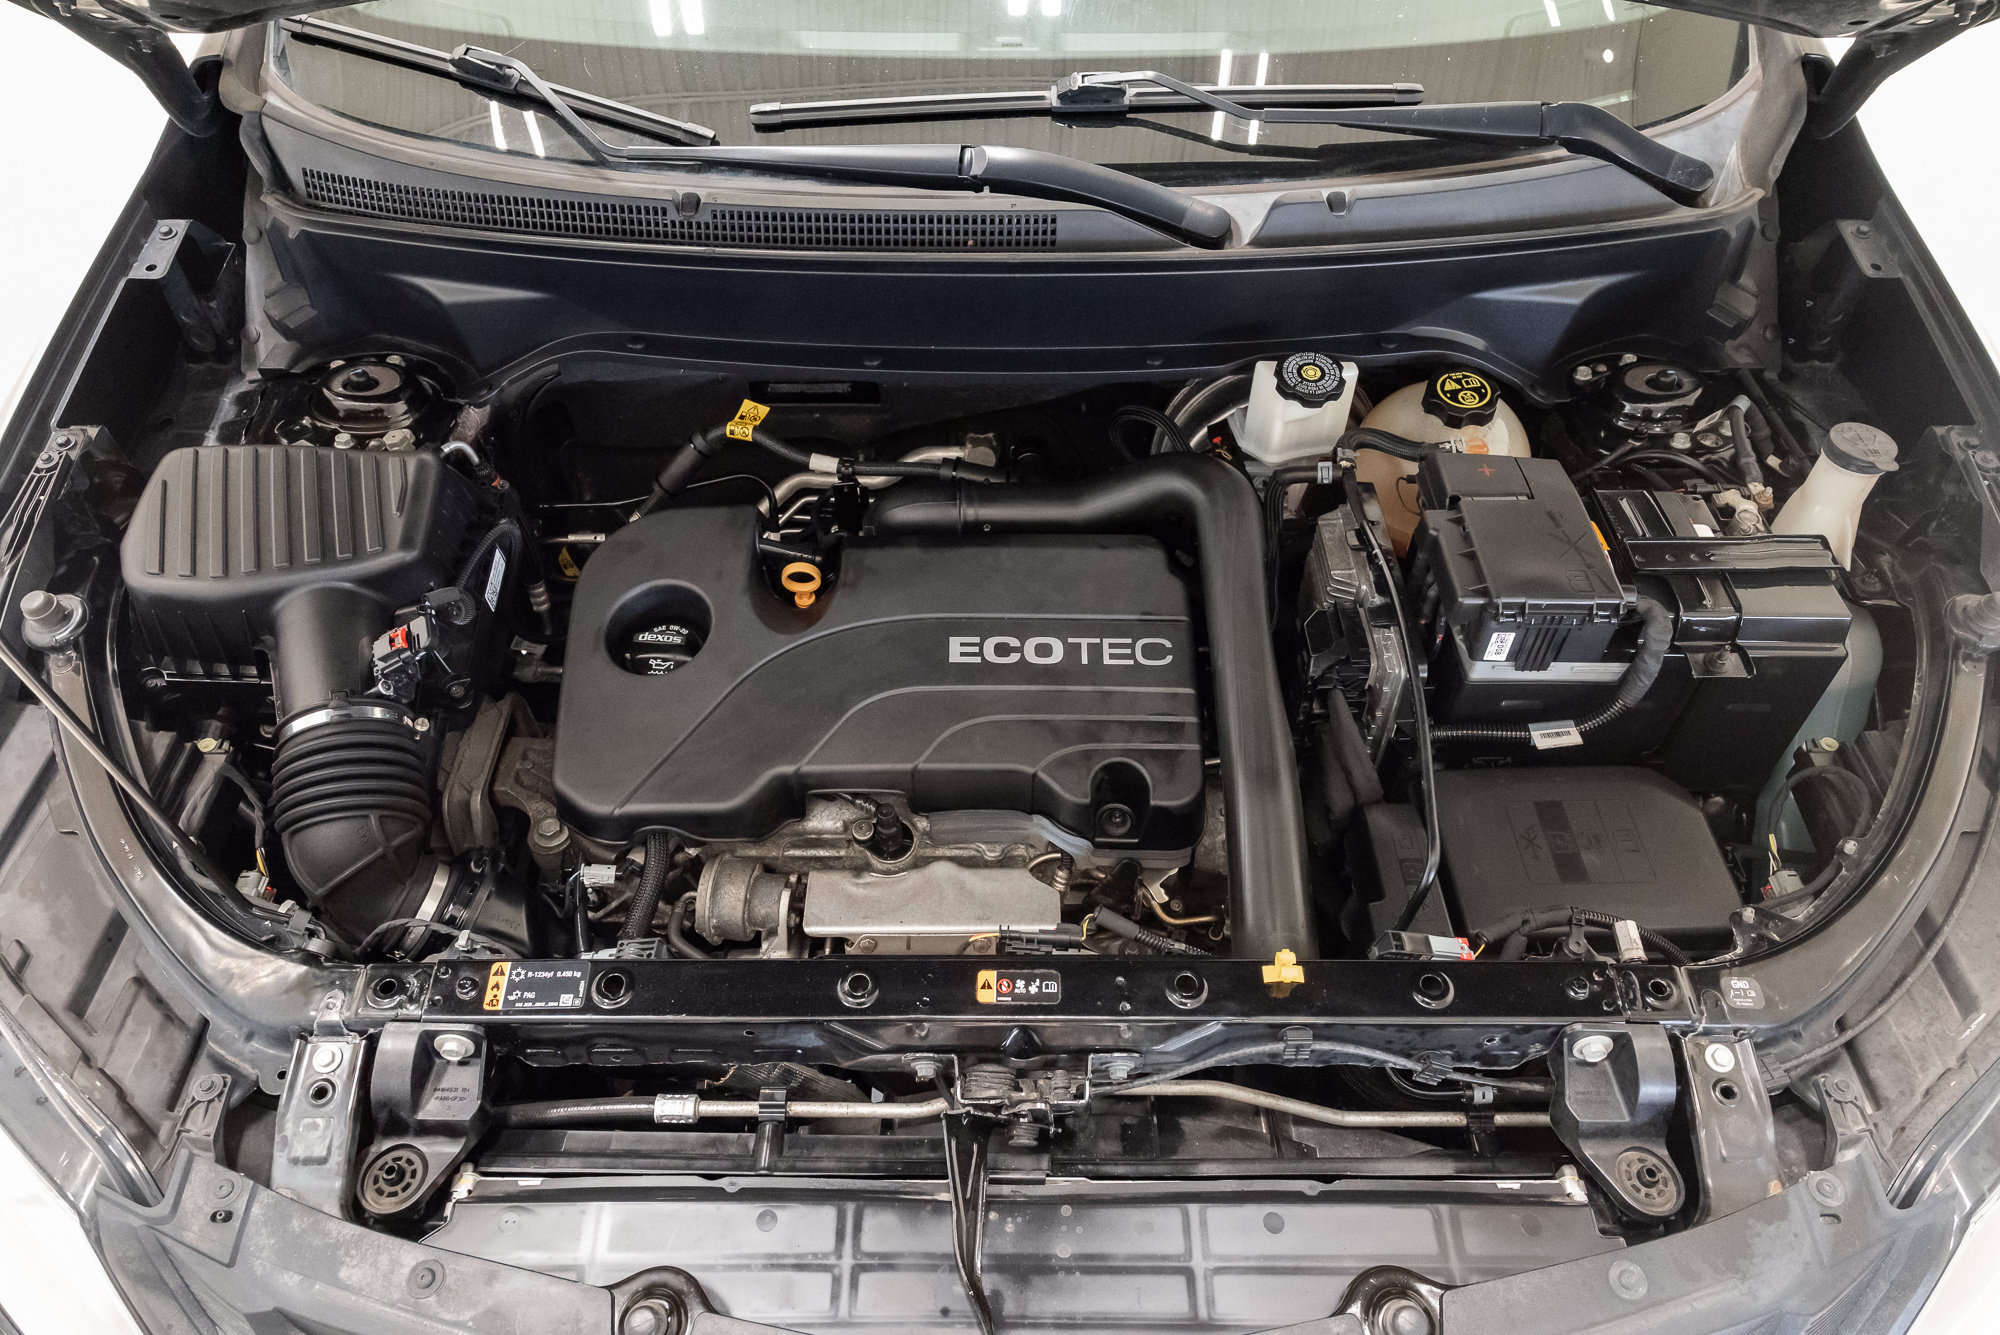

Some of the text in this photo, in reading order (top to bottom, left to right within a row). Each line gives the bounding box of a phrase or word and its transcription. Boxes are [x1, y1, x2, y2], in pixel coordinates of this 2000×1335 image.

[653, 624, 667, 633] SAE
[638, 631, 684, 644] dexos
[948, 636, 1174, 666] ECOTEC
[527, 970, 582, 979] R-1234yf 0.450 kg
[1730, 980, 1749, 989] GND
[522, 991, 536, 999] PAG
